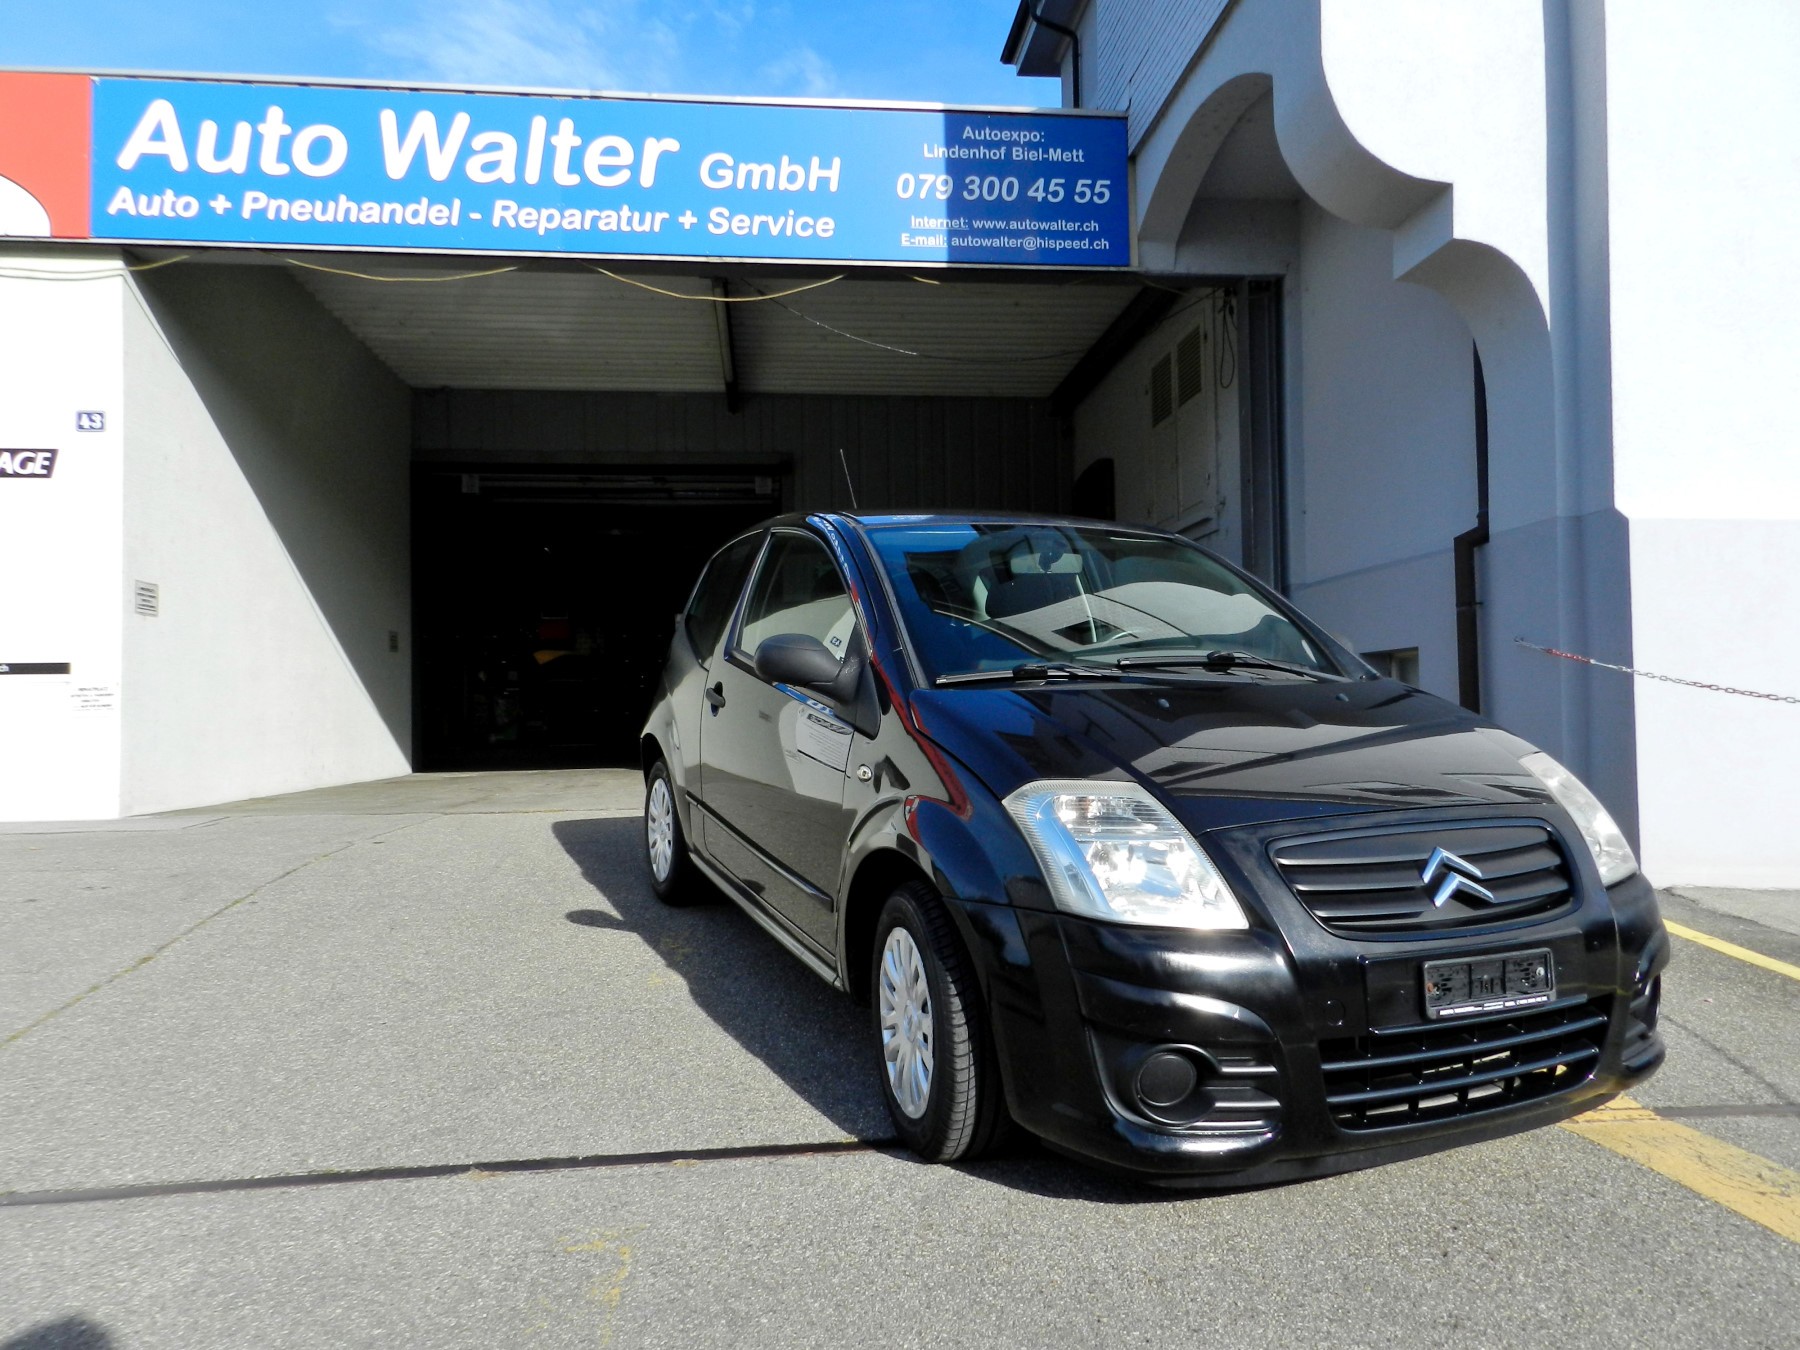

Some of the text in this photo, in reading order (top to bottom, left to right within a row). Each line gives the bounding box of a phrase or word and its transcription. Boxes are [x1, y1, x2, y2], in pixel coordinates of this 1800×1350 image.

[117, 98, 842, 192] Auto Walter GmbH
[962, 125, 1045, 145] Autoexpo:
[923, 143, 1085, 163] Lindenhof Biel-Mett
[896, 173, 1111, 204] 079 300 45 55
[107, 186, 199, 218] Auto
[241, 190, 461, 227] Pneuhandel
[492, 199, 670, 236] Reparatur
[707, 207, 836, 238] Service
[911, 215, 1099, 232] Internet: www.autowalter.ch
[901, 233, 1110, 251] E-mail: autowalter@hispeed.ch
[79, 413, 102, 429] 43
